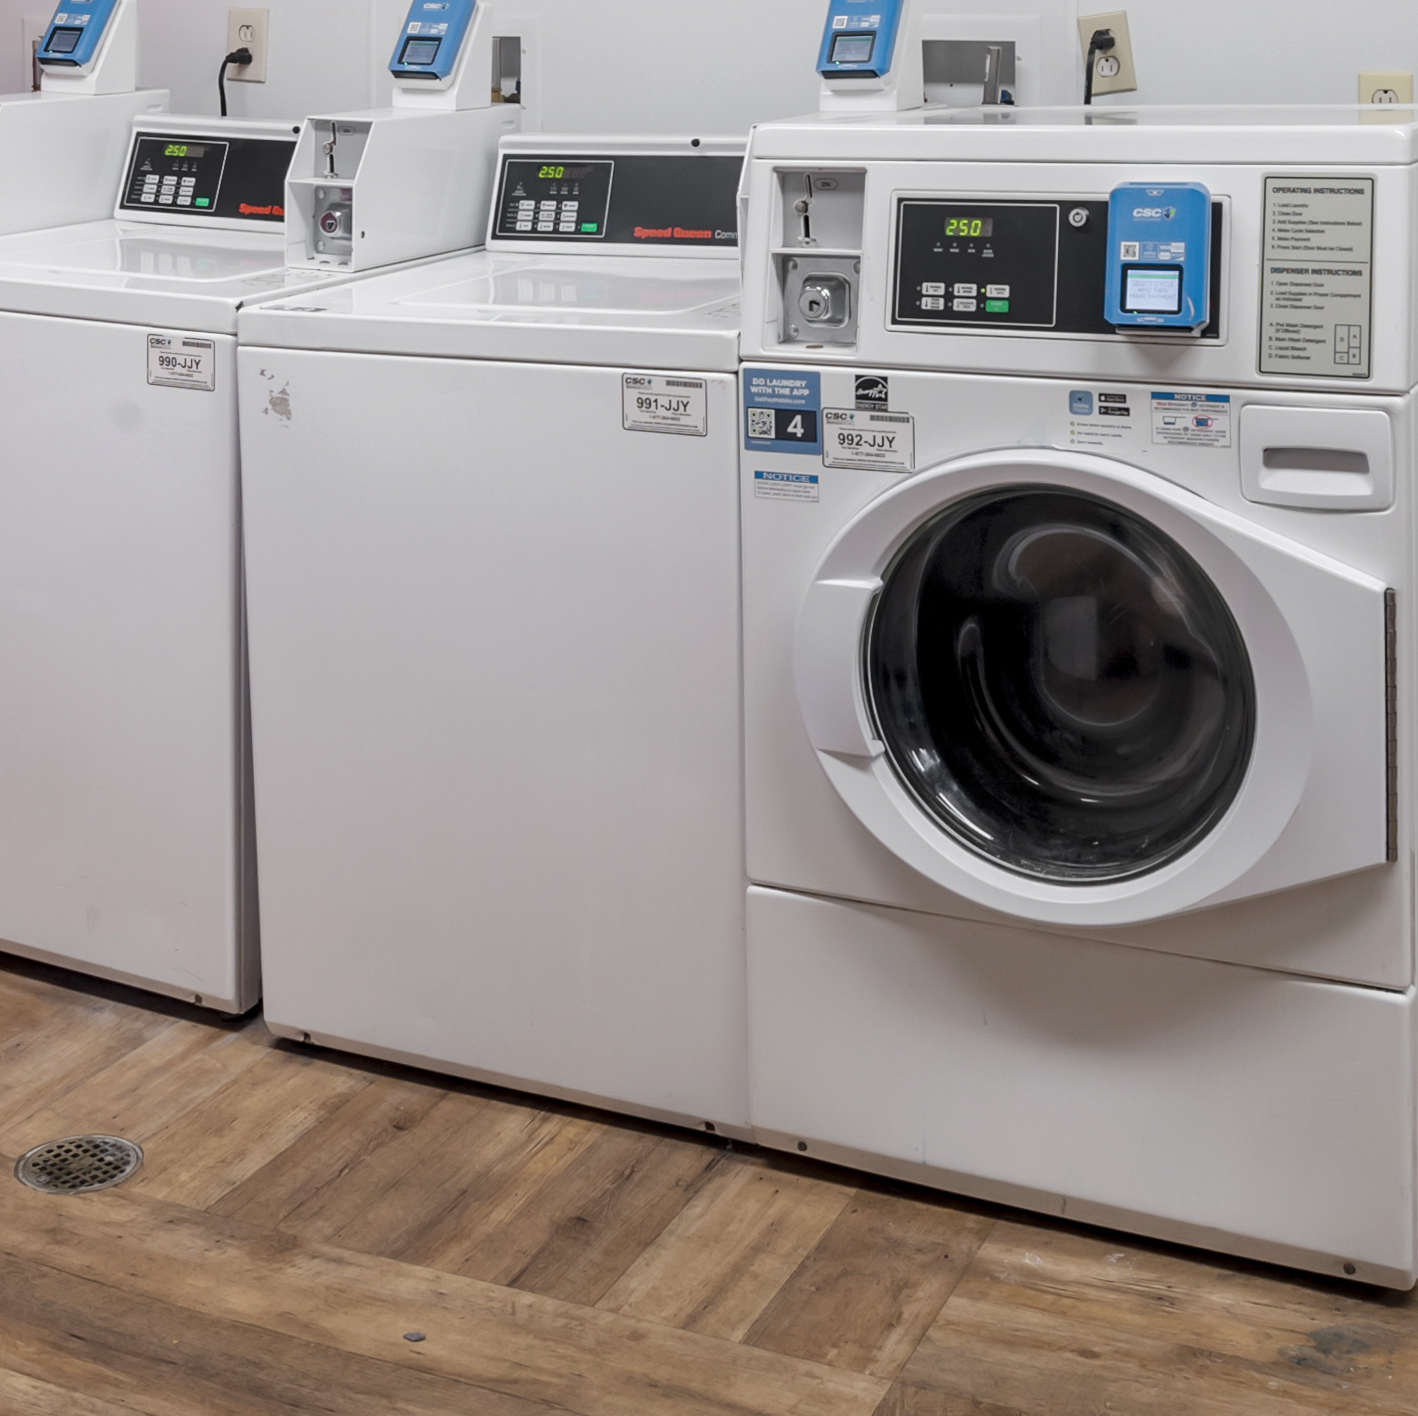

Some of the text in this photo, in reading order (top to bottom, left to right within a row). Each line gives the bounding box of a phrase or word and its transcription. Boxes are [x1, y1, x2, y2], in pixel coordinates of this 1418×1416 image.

[1133, 208, 1161, 217] CSC
[633, 227, 672, 239] Speed
[673, 227, 712, 239] Queen
[1271, 267, 1363, 276] DISPENSER INSTRUCTIONS
[159, 355, 201, 369] 990-JJY
[625, 377, 646, 385] CSC
[752, 377, 807, 387] DO LAUNDRY
[750, 386, 810, 396] WITH THE APP
[1173, 393, 1206, 401] NOTICE
[636, 396, 690, 412] 991-JJY
[825, 412, 847, 420] CSC
[787, 414, 804, 438] 4
[838, 432, 896, 448] 992-JJY
[762, 472, 810, 482] NOTICE
